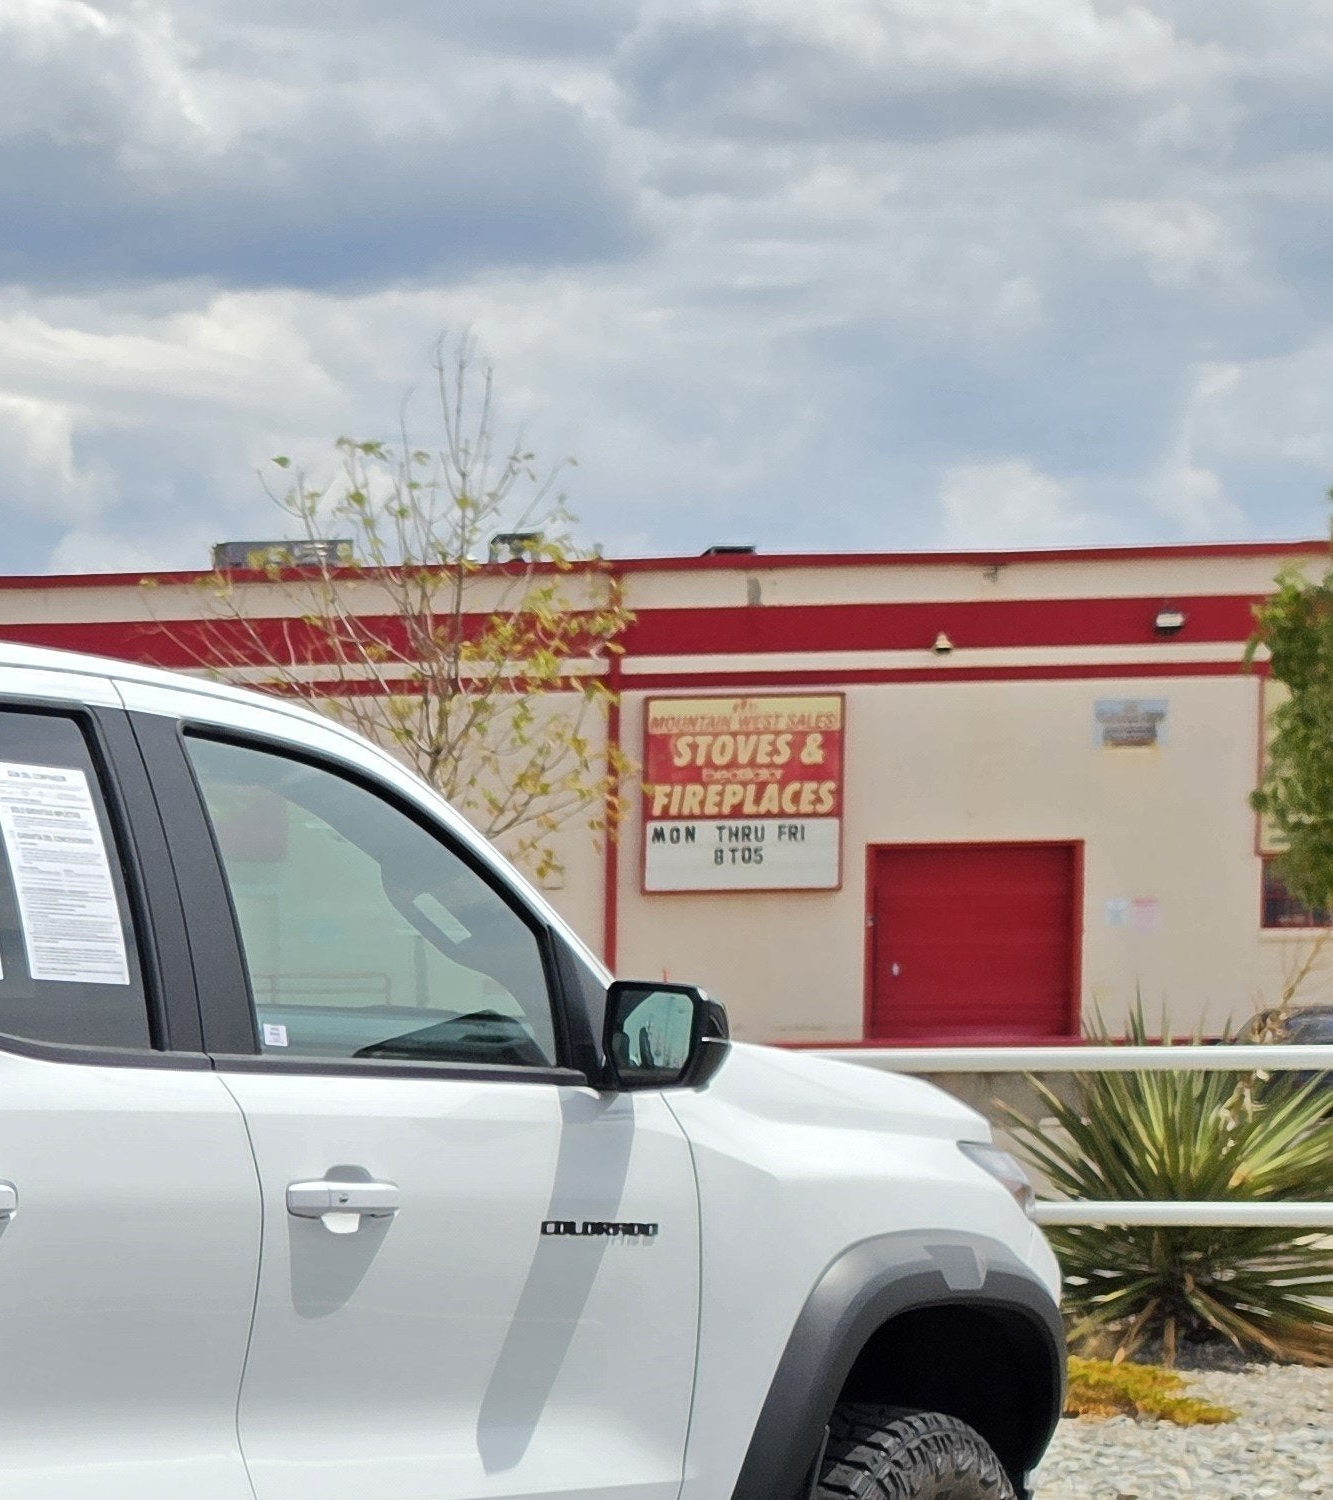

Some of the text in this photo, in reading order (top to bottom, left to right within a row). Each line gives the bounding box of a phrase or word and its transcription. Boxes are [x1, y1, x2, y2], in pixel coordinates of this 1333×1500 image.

[738, 714, 782, 729] WEST
[673, 733, 824, 766] STOVES &
[651, 781, 836, 817] FIREPLACES
[651, 823, 806, 844] MON THRU FRI
[541, 1221, 659, 1236] COLORADO
